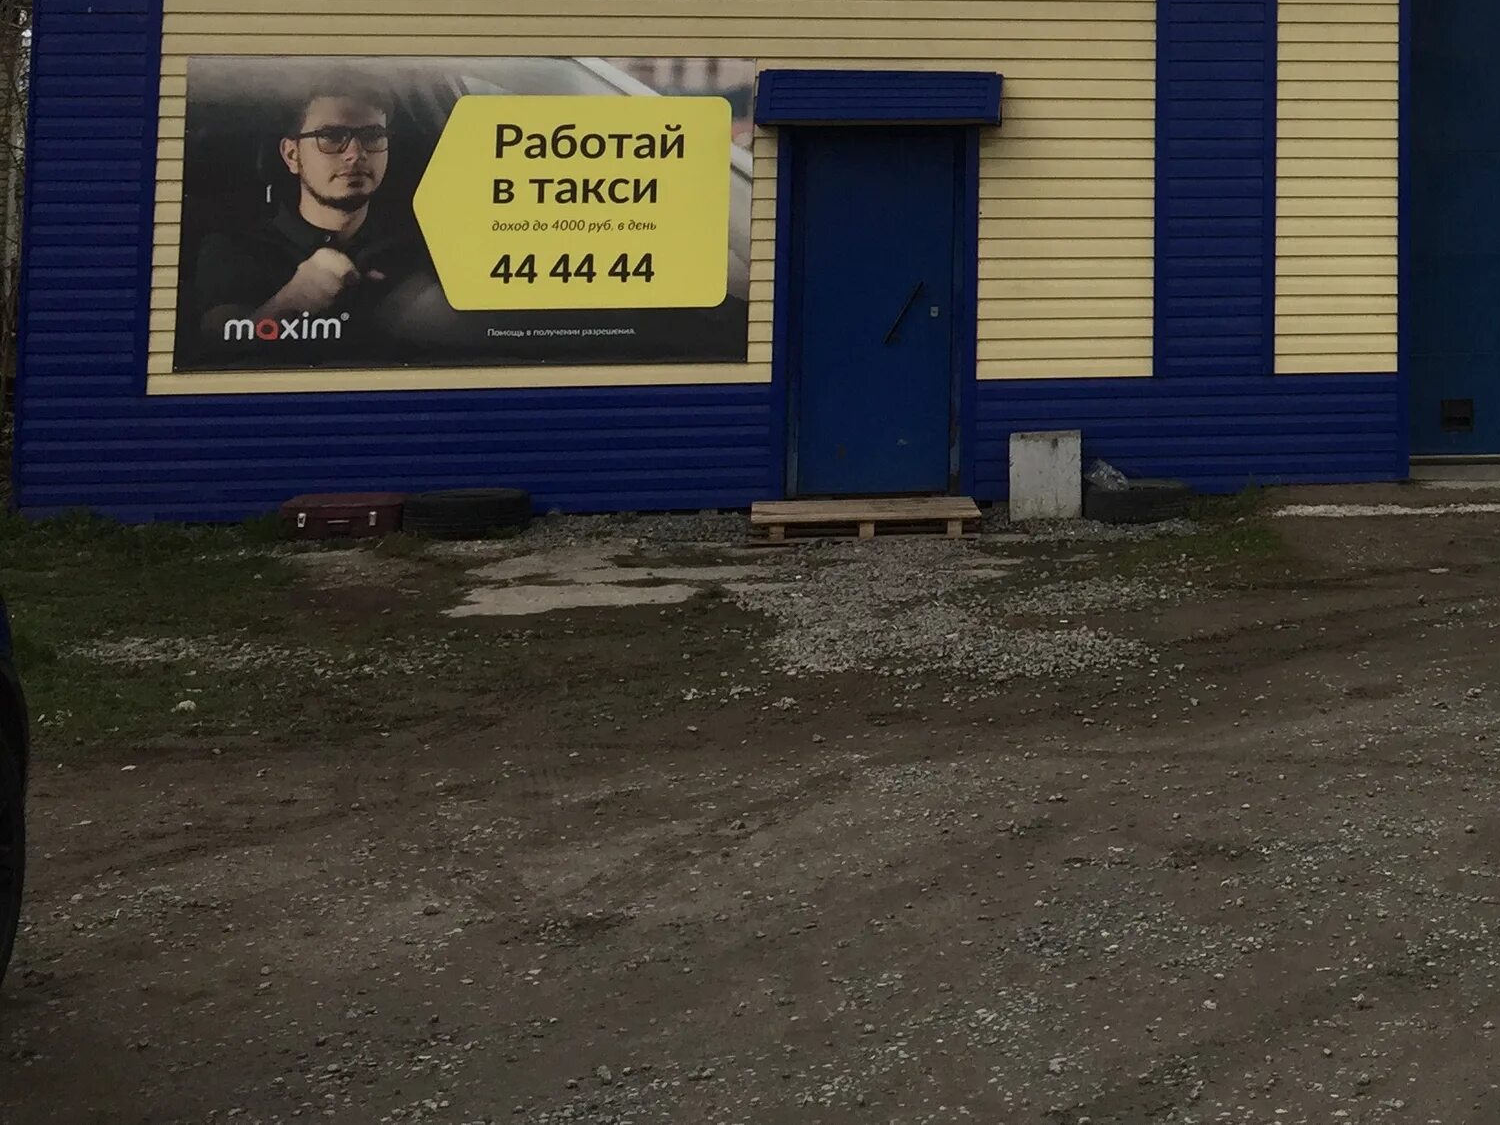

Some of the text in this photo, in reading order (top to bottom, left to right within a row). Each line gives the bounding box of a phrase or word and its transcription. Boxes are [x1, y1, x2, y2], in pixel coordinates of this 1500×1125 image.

[495, 123, 685, 159] Работай
[493, 178, 658, 204] в такси
[492, 220, 530, 232] доход
[532, 220, 549, 232] до
[551, 219, 586, 231] 4000
[617, 222, 625, 231] в
[627, 220, 657, 231] день
[490, 253, 655, 284] 44 44 44
[487, 328, 525, 338] Помощь
